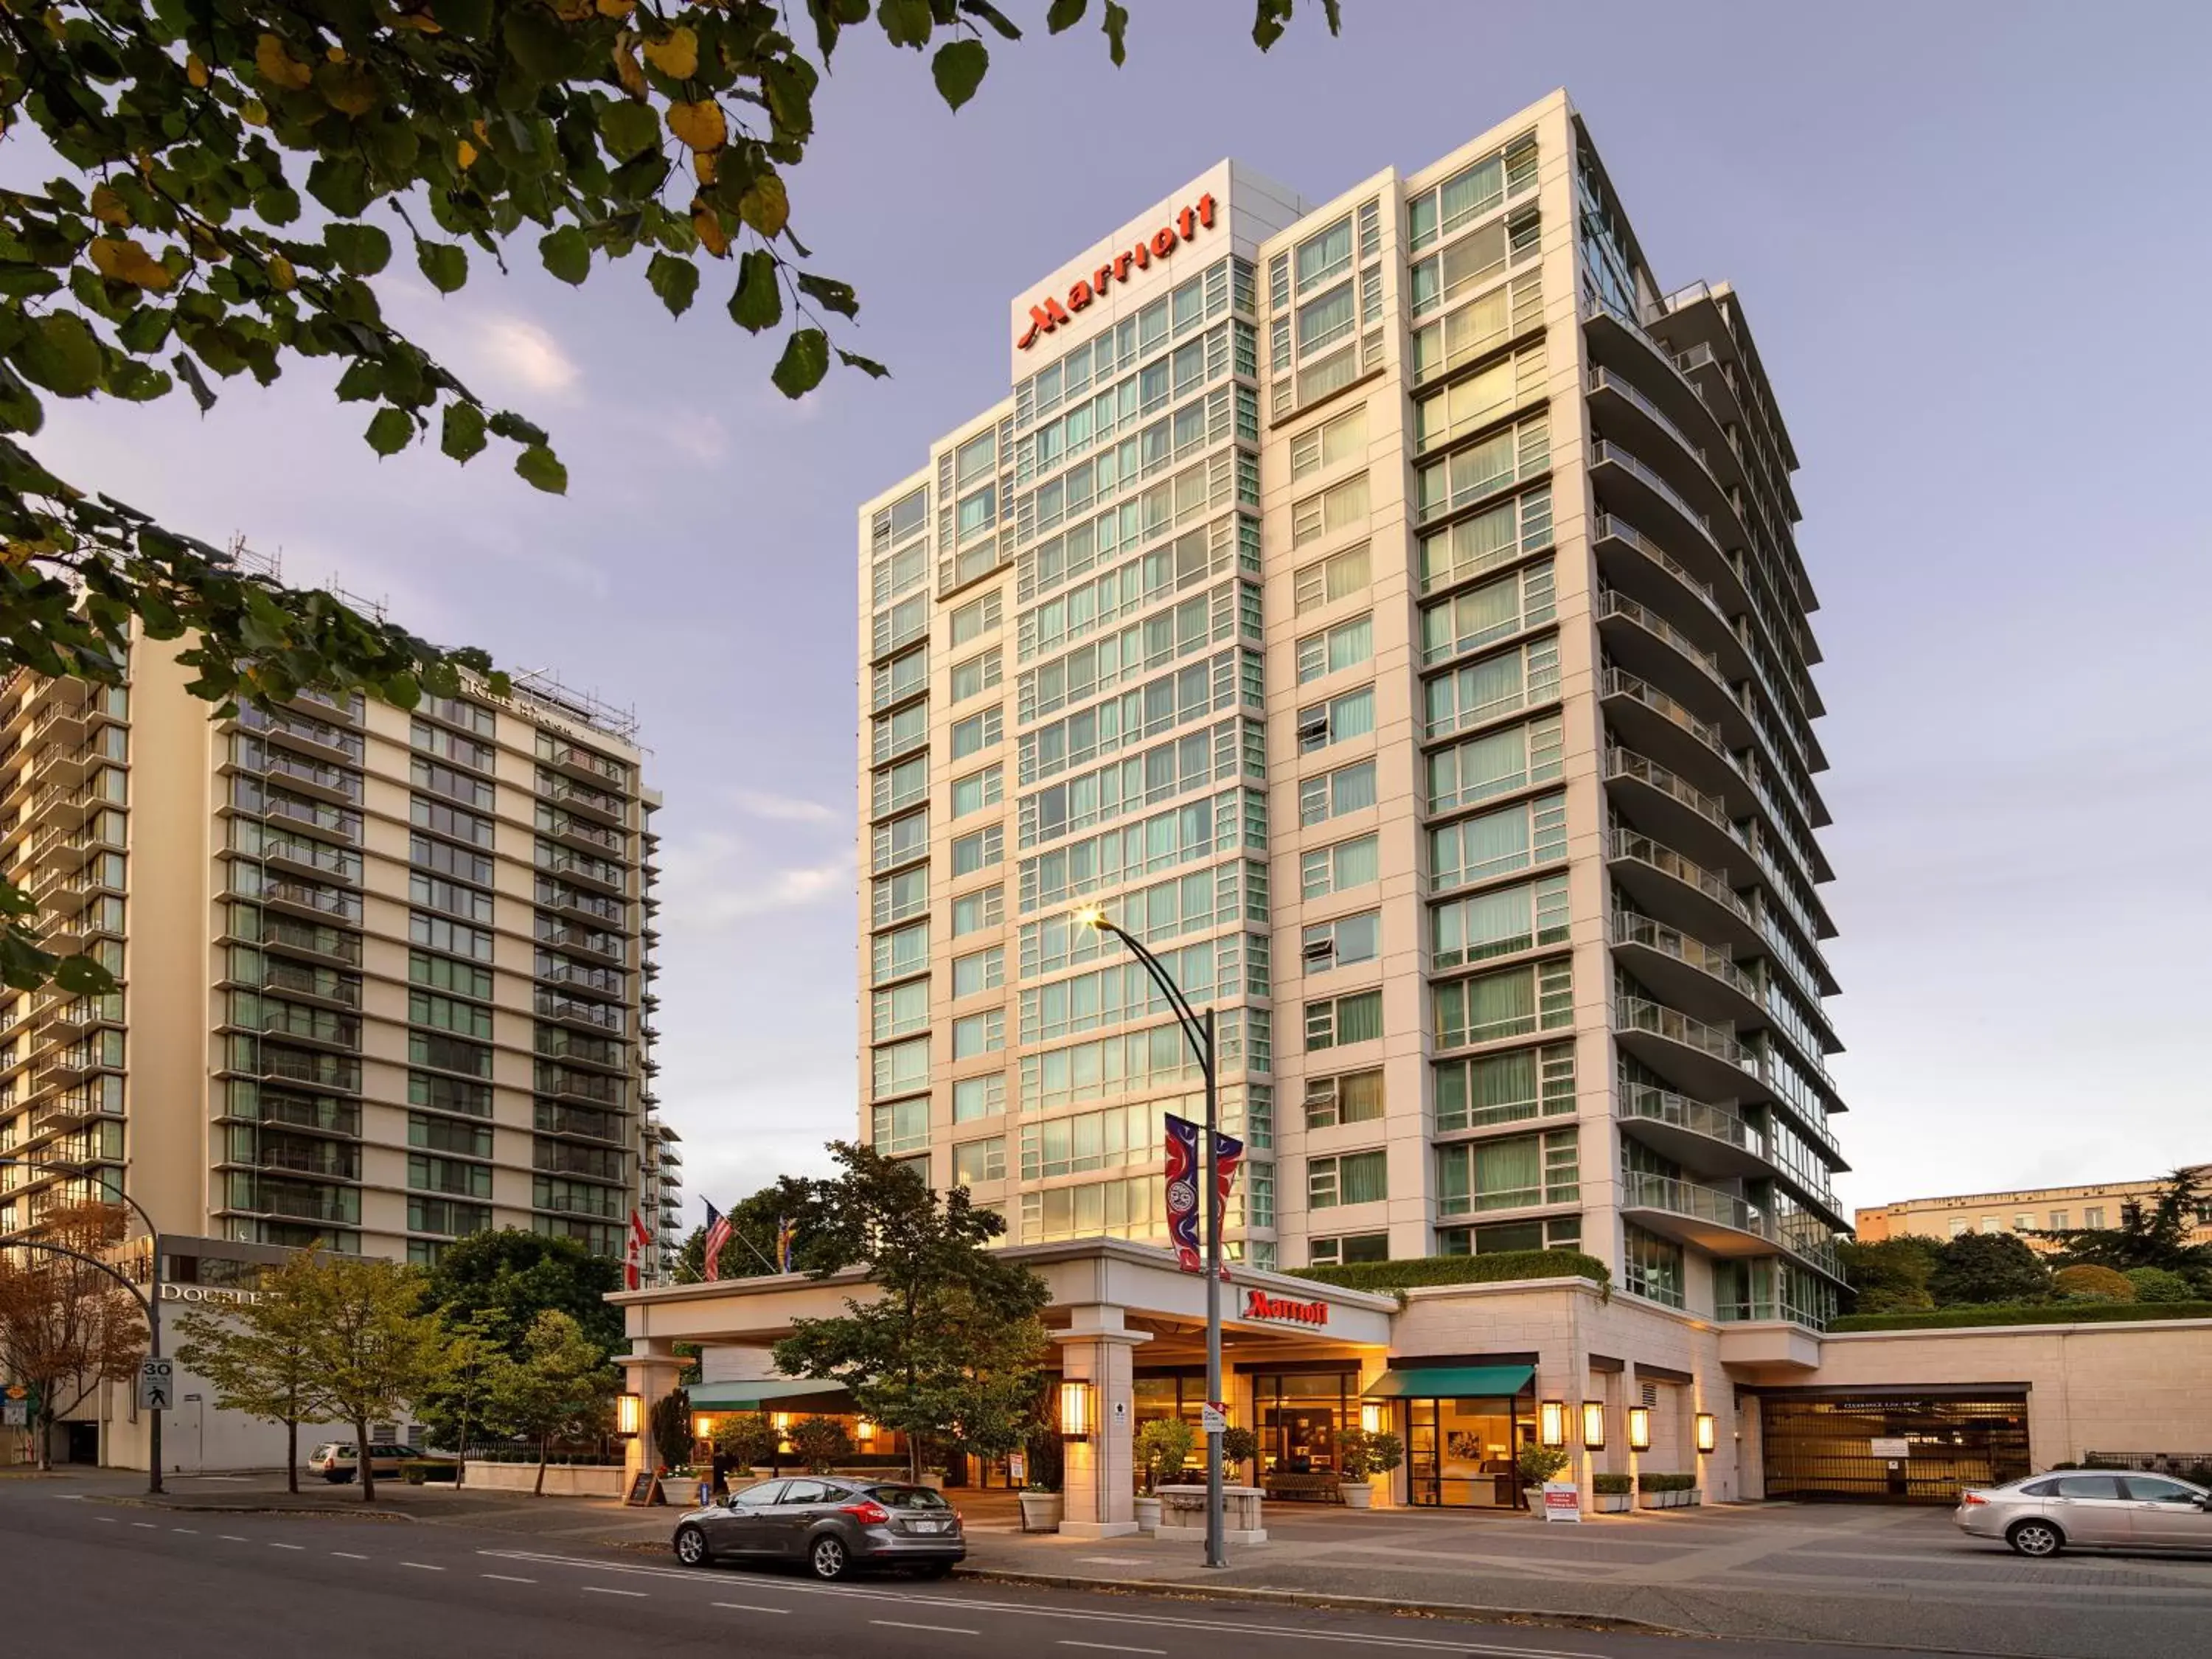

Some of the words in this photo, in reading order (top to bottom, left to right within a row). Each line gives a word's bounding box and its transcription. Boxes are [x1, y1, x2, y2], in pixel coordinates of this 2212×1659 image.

[1018, 192, 1215, 349] Marriott
[1242, 1290, 1329, 1325] Marriott
[144, 1363, 170, 1375] 30
